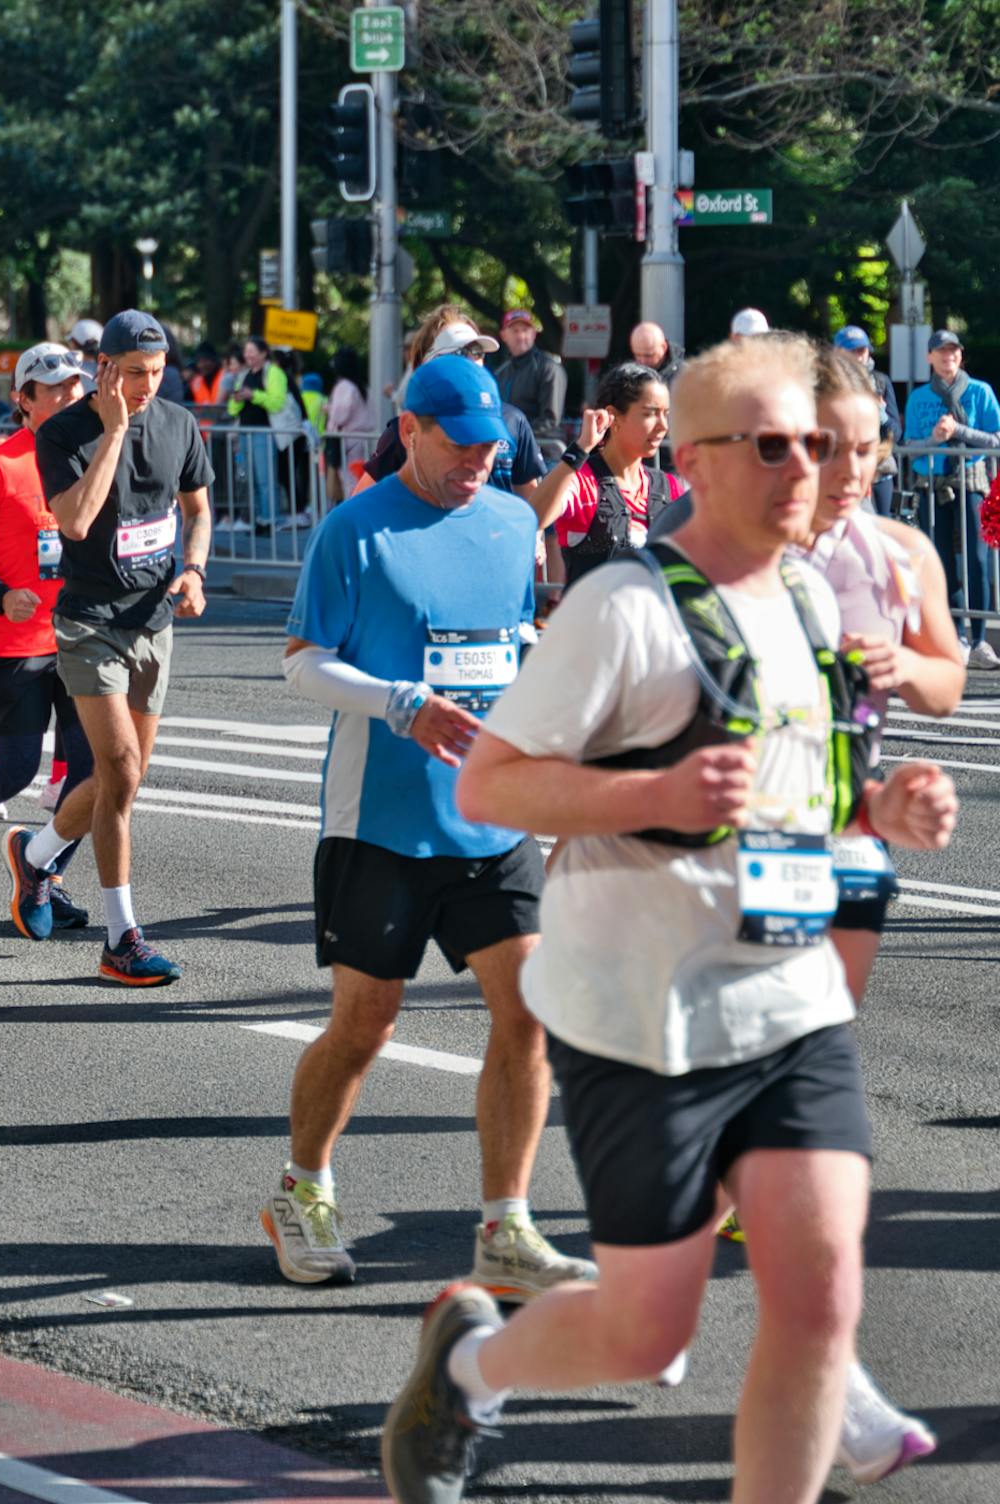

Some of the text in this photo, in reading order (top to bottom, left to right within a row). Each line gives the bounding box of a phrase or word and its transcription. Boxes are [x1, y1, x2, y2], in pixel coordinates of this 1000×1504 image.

[696, 193, 759, 213] Oxford St
[459, 668, 494, 681] THOMAS
